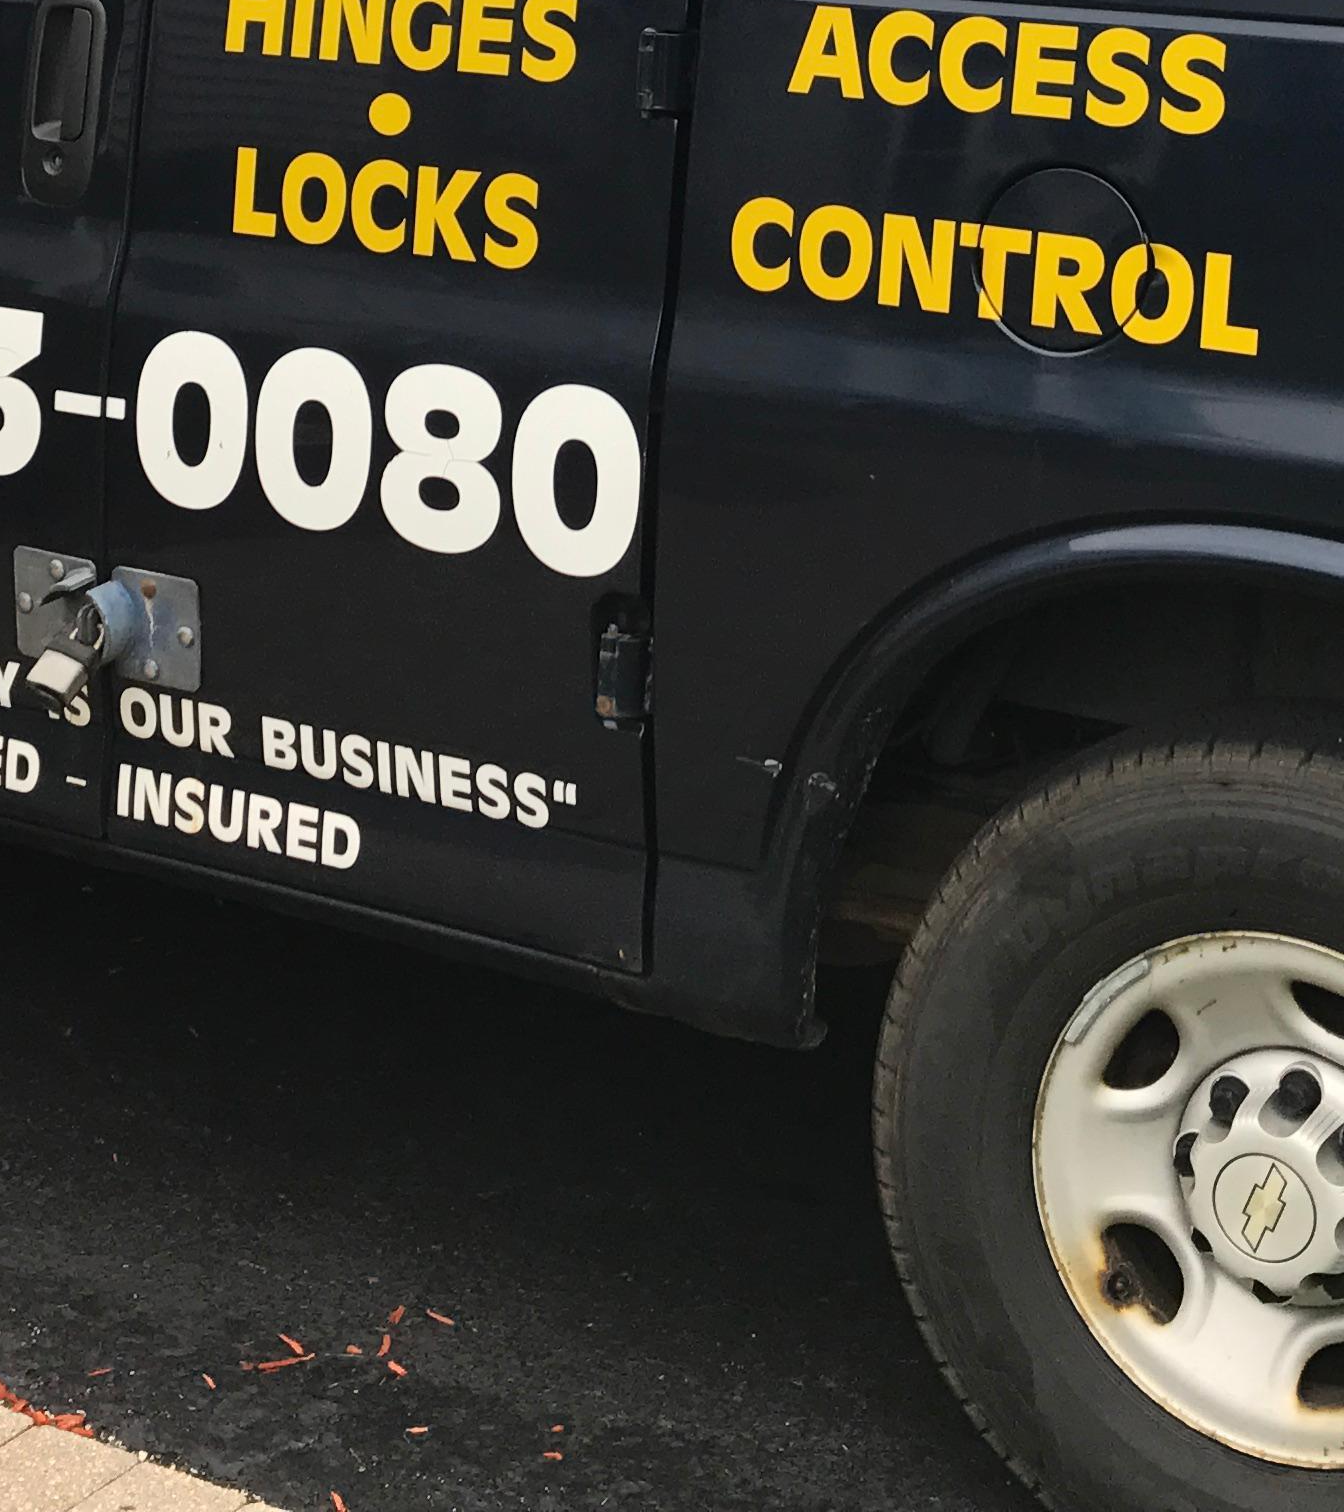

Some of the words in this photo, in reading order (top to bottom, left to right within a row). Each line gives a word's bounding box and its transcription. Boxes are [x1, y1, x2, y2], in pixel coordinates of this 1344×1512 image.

[788, 6, 1227, 135] ACCESS
[233, 146, 540, 270] LOCKS
[731, 196, 1259, 356] CONTROL
[120, 686, 234, 759] OUR
[116, 763, 361, 869] INSURED
